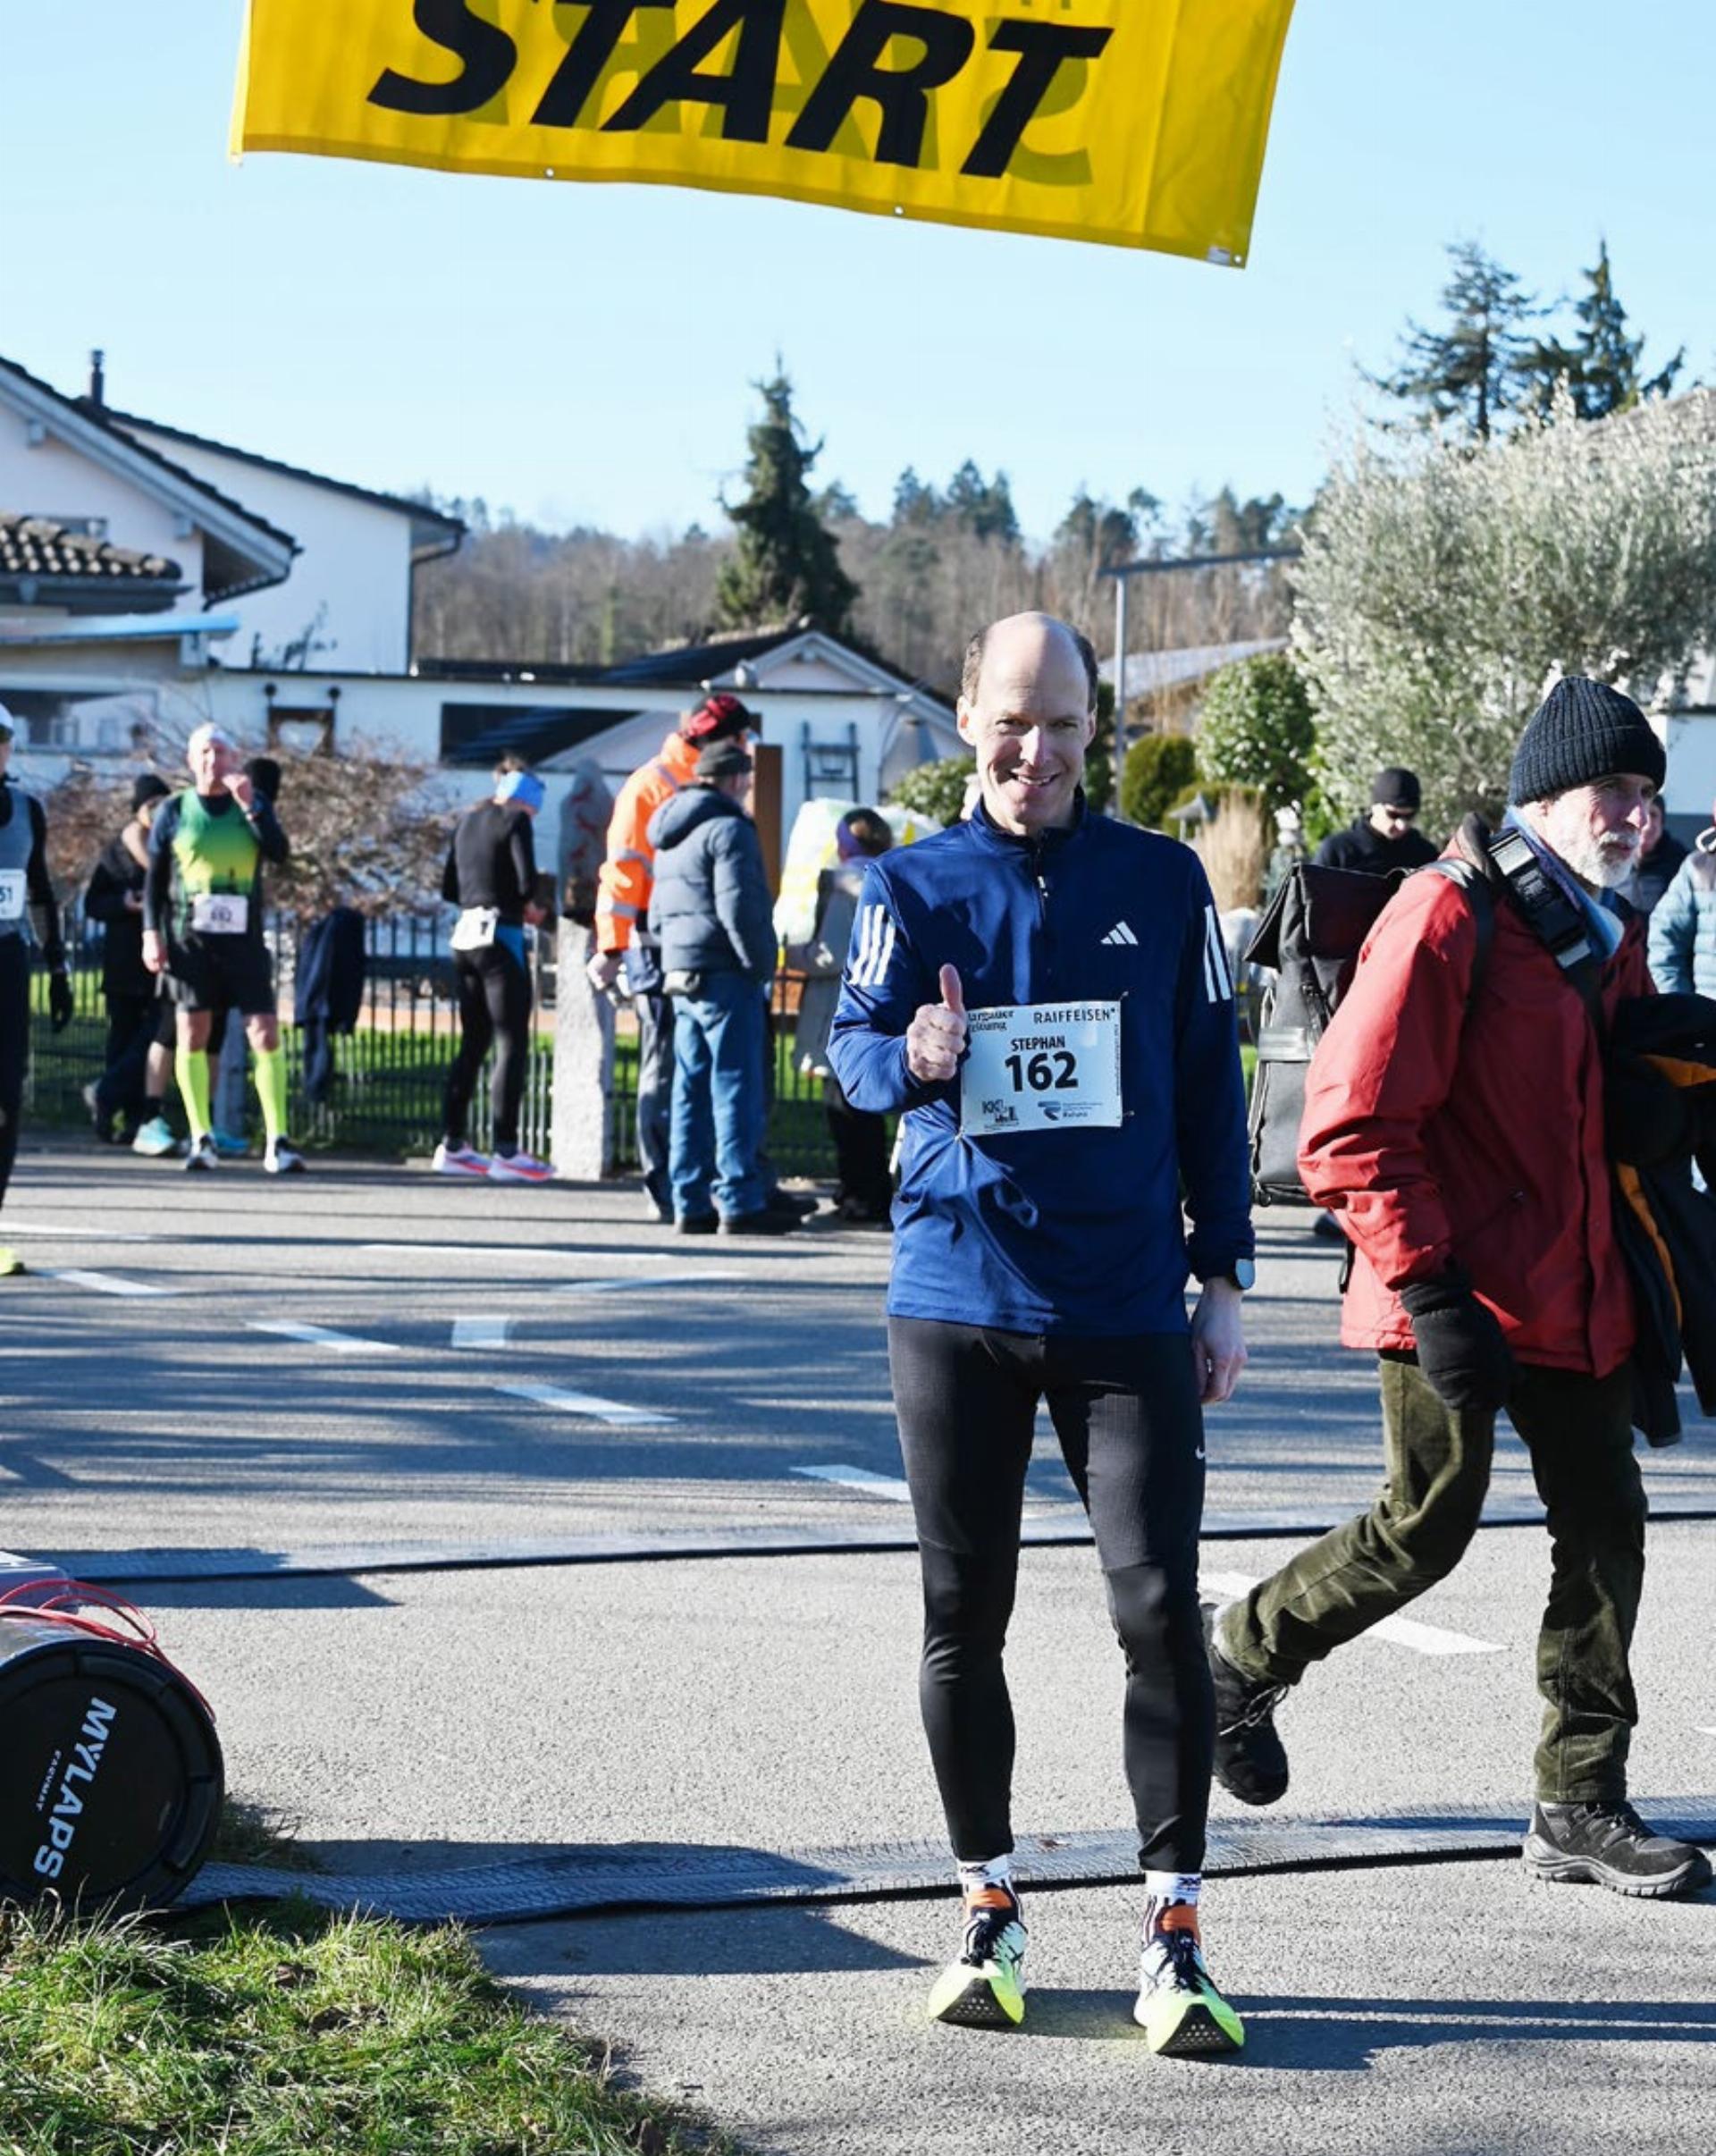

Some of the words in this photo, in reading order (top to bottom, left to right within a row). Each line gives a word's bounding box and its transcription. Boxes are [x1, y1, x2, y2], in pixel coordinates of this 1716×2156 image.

[367, 0, 1115, 179] START
[1033, 1008, 1111, 1024] RAIFFEISEN
[1011, 1035, 1065, 1052] STEPHAN
[1005, 1051, 1079, 1092] 162
[33, 1697, 117, 1878] MYLAPS
